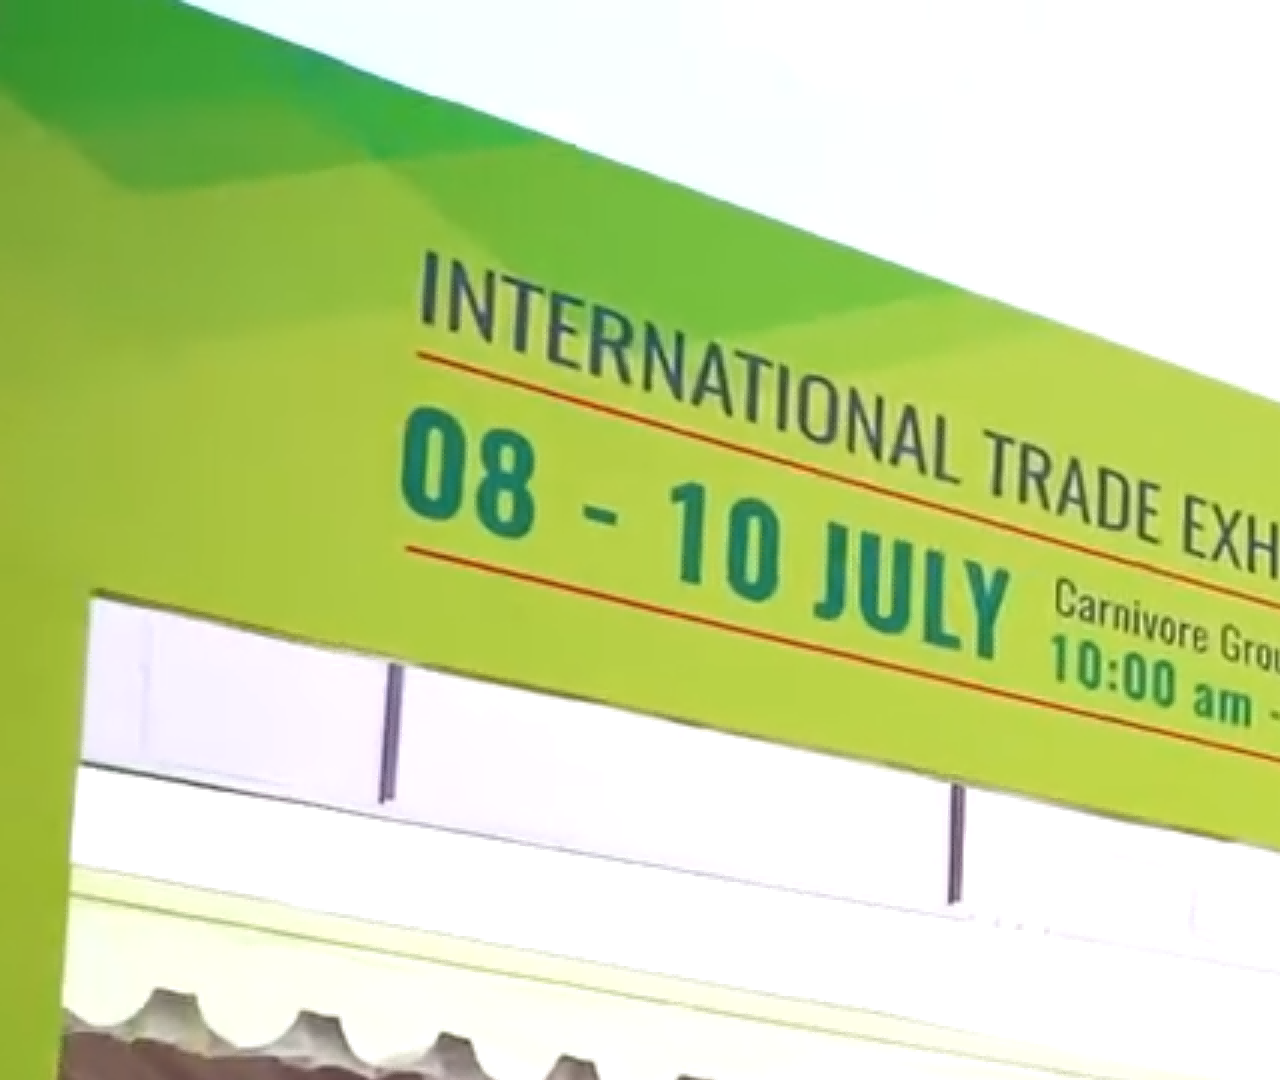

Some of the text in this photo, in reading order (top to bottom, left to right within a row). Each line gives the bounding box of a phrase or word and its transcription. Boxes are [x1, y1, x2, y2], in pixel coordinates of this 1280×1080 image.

[420, 249, 961, 485] INTERNATIONAL
[983, 429, 1162, 546] TRADE
[400, 405, 1011, 661] 08 - 10 JULY
[1054, 577, 1209, 655] Carnivore
[1050, 632, 1175, 708] 10:00
[1194, 682, 1252, 729] am
